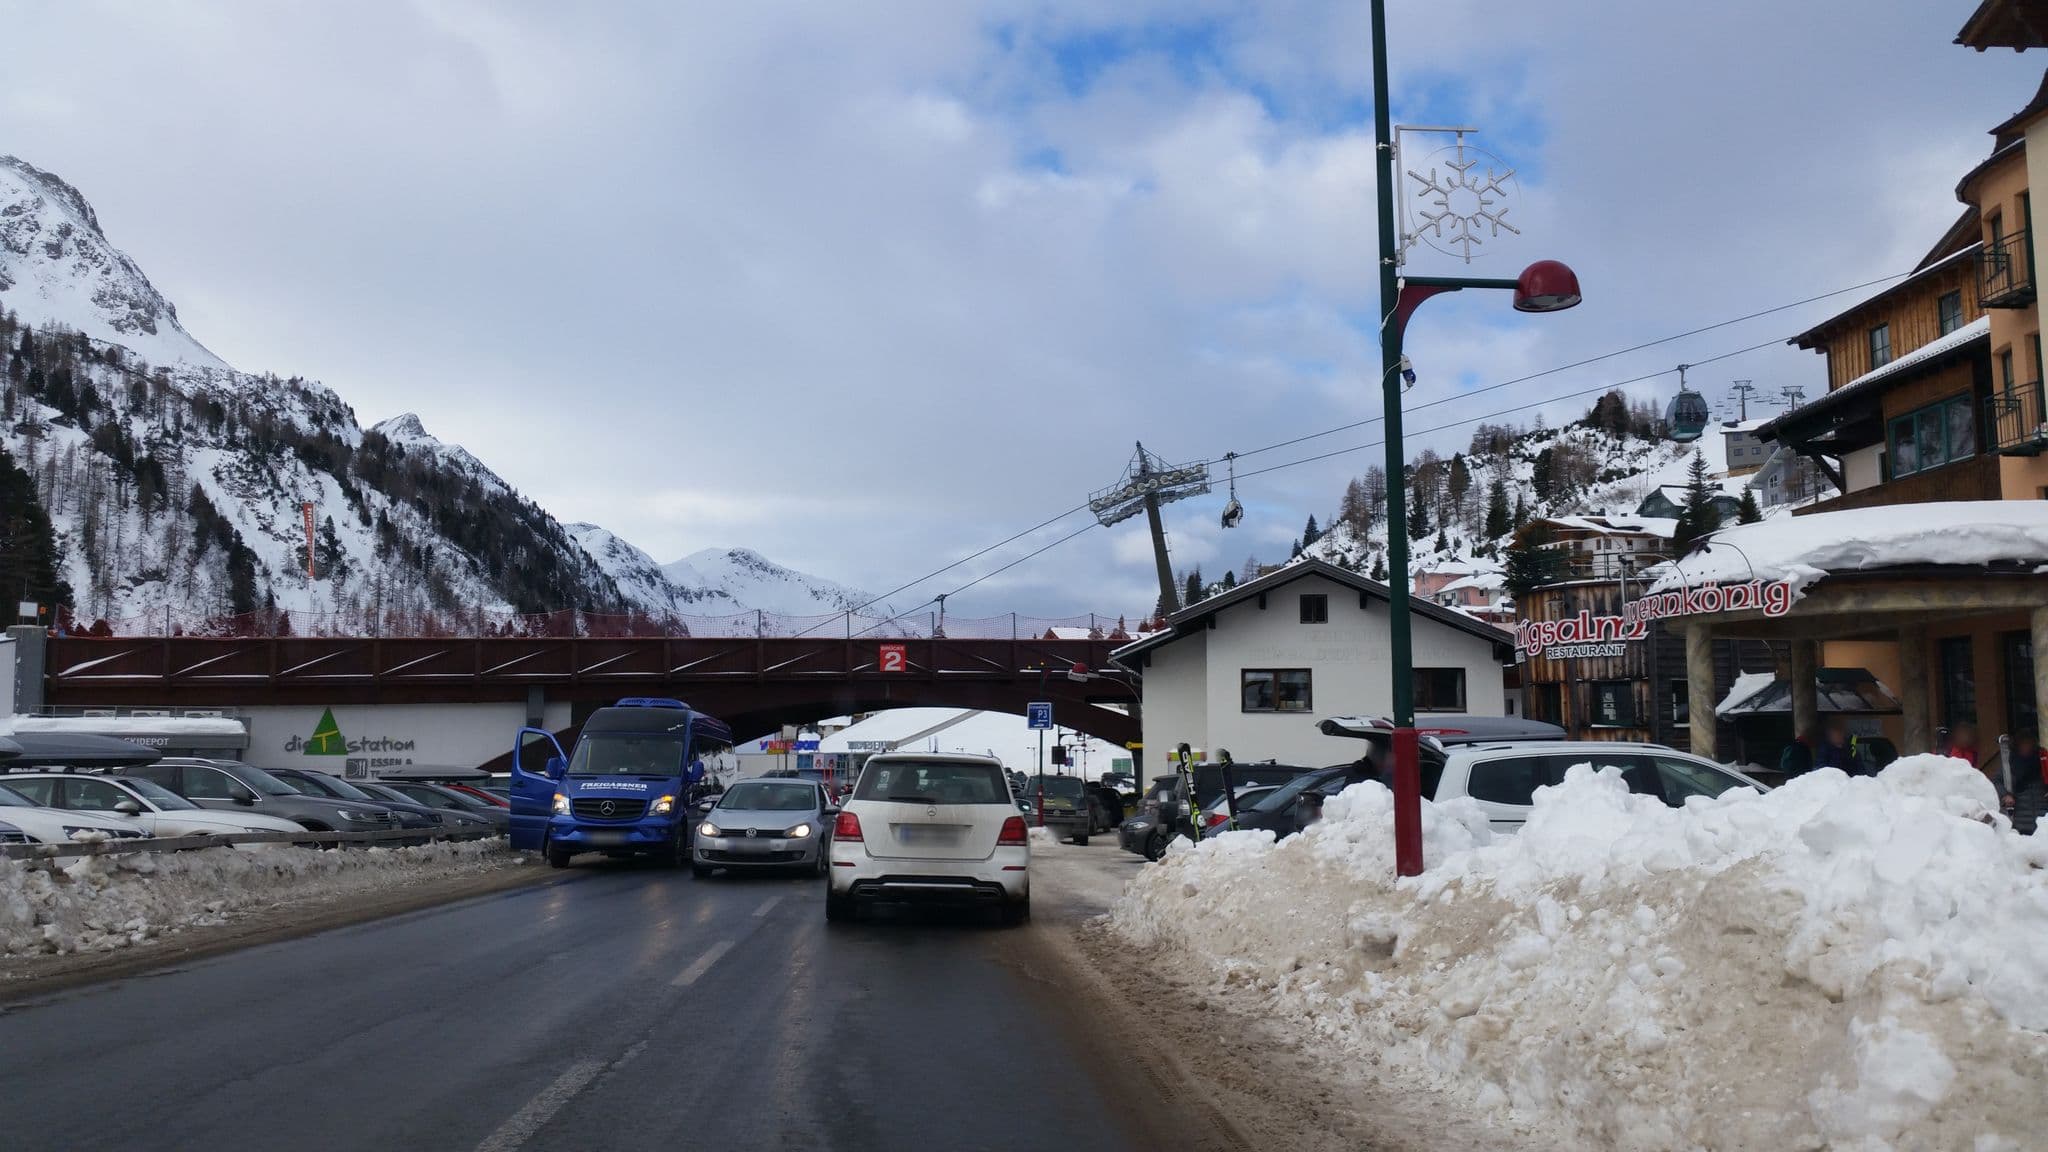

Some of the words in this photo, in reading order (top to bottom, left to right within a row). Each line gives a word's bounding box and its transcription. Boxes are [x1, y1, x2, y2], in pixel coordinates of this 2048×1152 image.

[1545, 643, 1626, 660] RESTAURANT
[885, 651, 901, 671] 2
[1037, 709, 1048, 719] P3
[371, 758, 402, 767] ESSEN
[1182, 751, 1196, 795] HEAD
